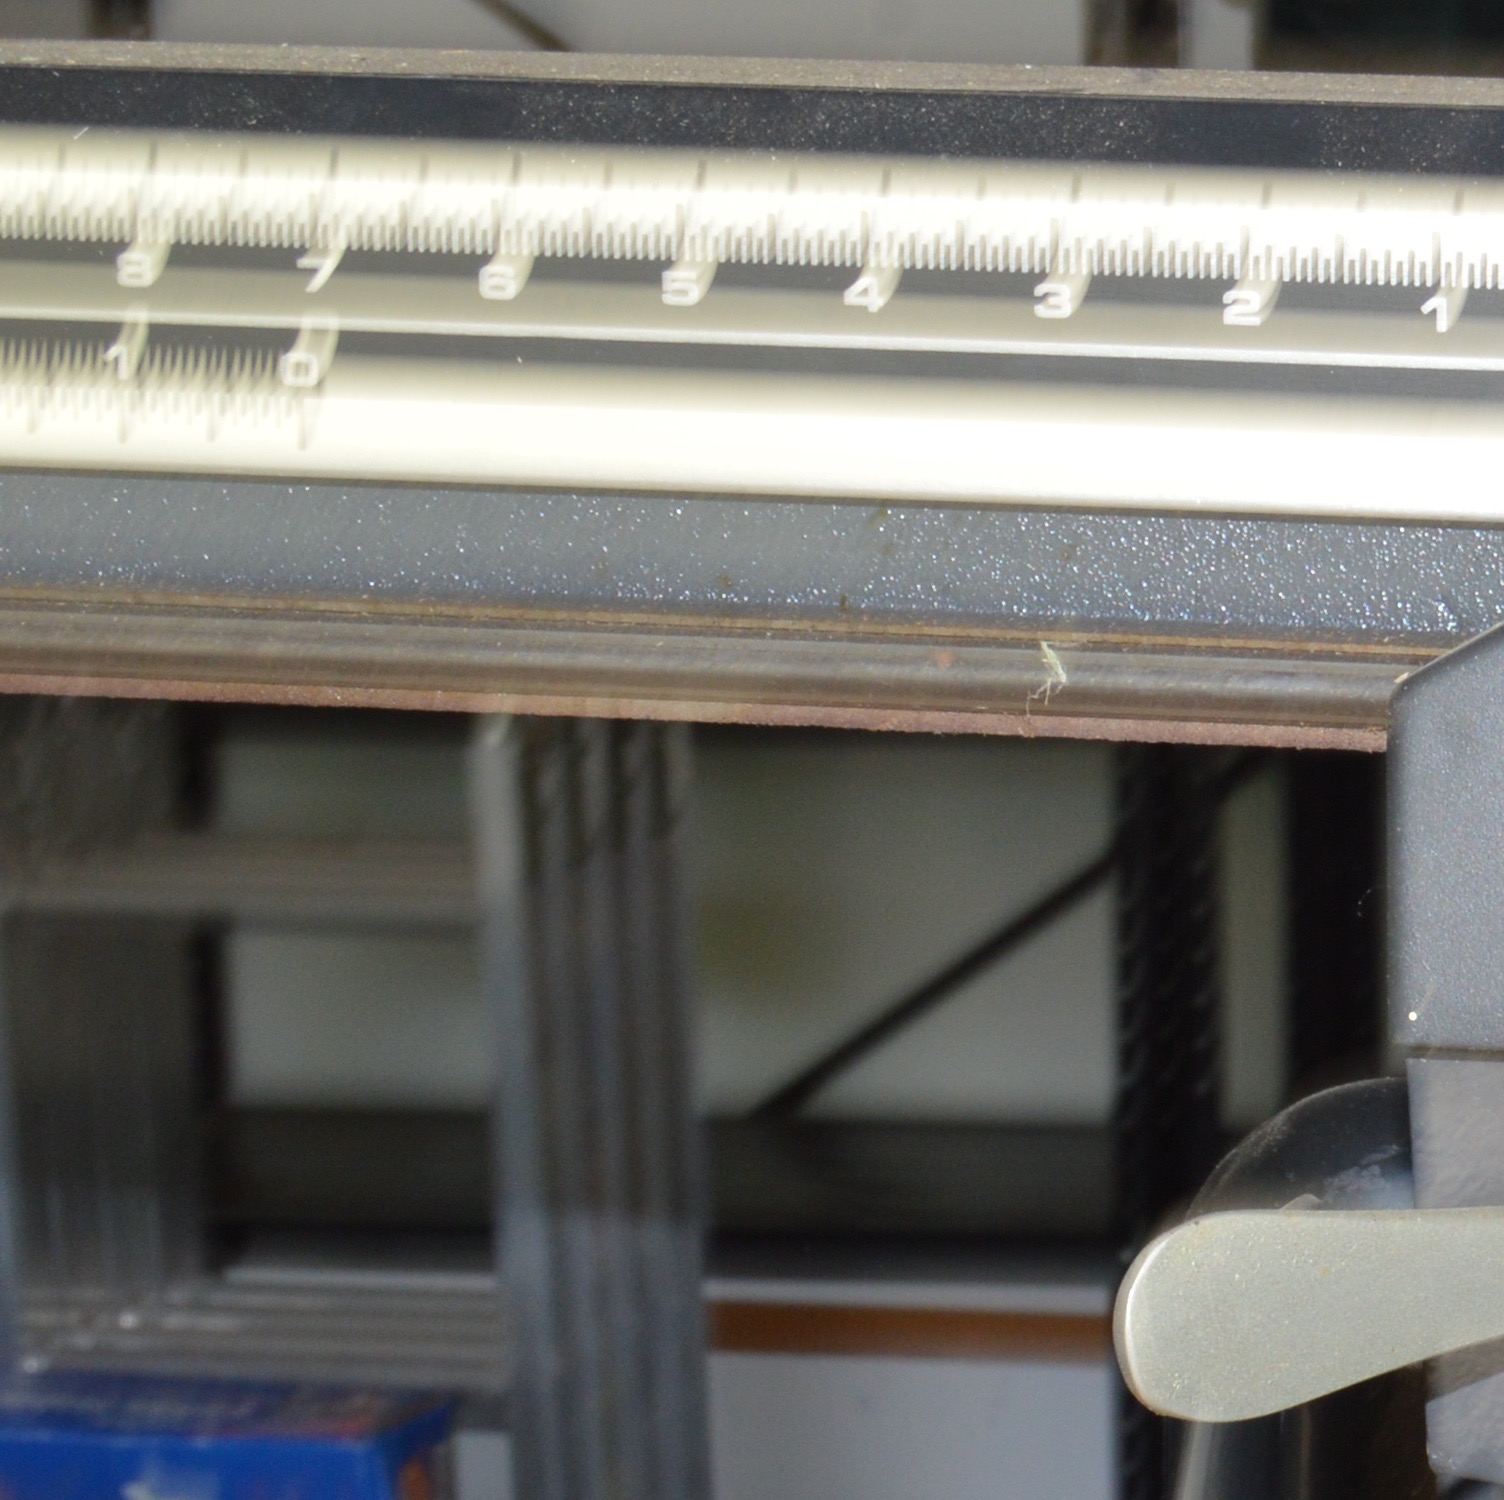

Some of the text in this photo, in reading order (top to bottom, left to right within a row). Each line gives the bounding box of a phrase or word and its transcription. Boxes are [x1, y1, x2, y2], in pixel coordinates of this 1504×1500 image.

[116, 250, 152, 287] 8
[297, 250, 336, 292] 7
[479, 266, 518, 300] 6
[662, 271, 702, 305] 5
[844, 277, 884, 312] 4
[1034, 284, 1072, 319] 3
[1222, 290, 1261, 325] 2
[1421, 297, 1450, 333] 1
[103, 344, 319, 388] 1 0
